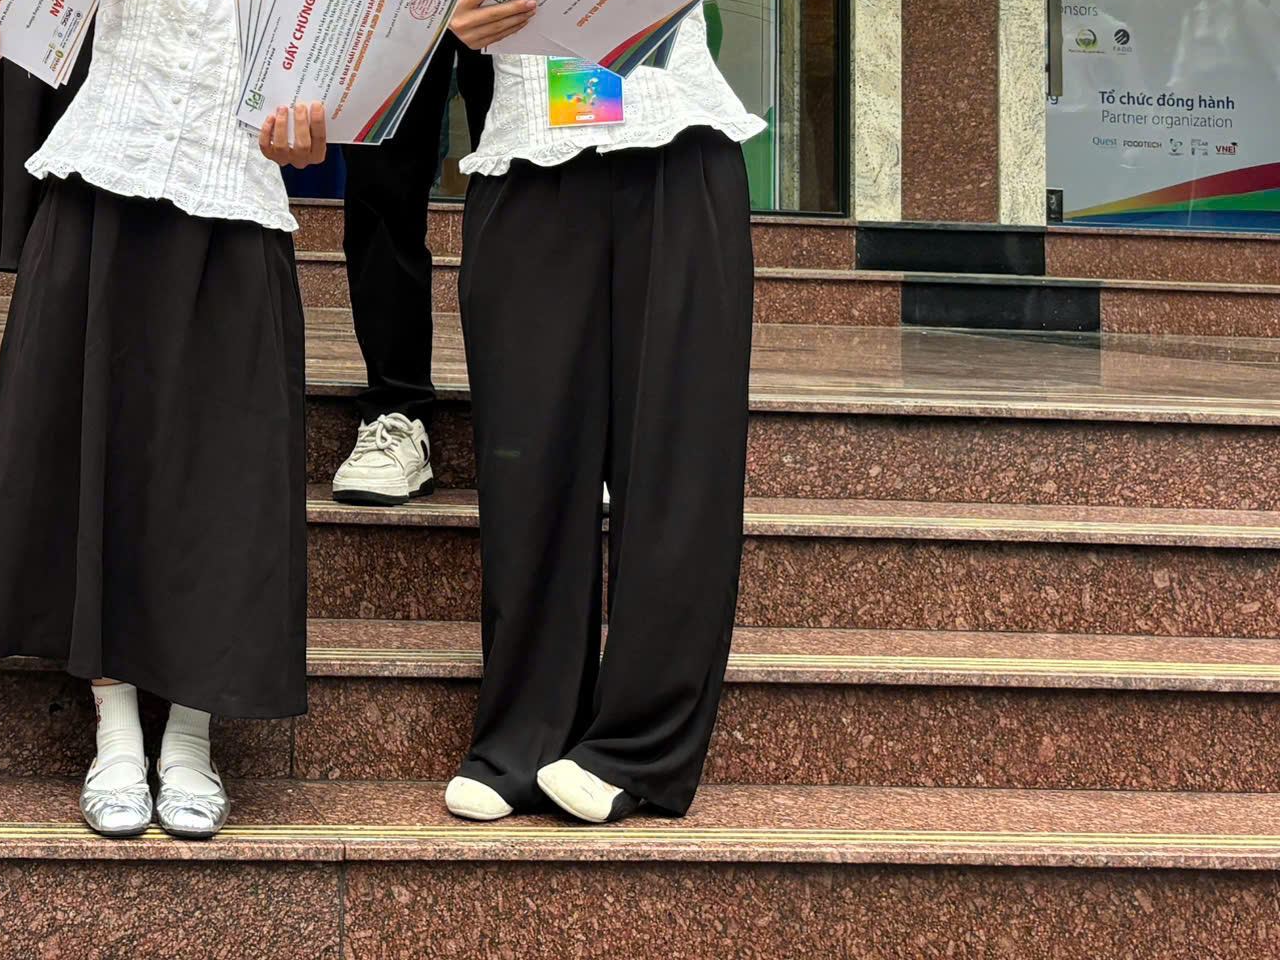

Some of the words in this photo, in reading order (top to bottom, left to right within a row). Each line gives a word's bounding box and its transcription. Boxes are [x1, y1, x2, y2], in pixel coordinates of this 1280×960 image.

[1061, 5, 1098, 17] nsors
[281, 41, 299, 69] GIẤY
[1098, 89, 1116, 105] Tổ
[1119, 92, 1154, 107] chức
[1157, 92, 1195, 111] đồng
[1198, 95, 1235, 110] hành
[1102, 110, 1148, 126] Partner
[1152, 114, 1233, 129] organization
